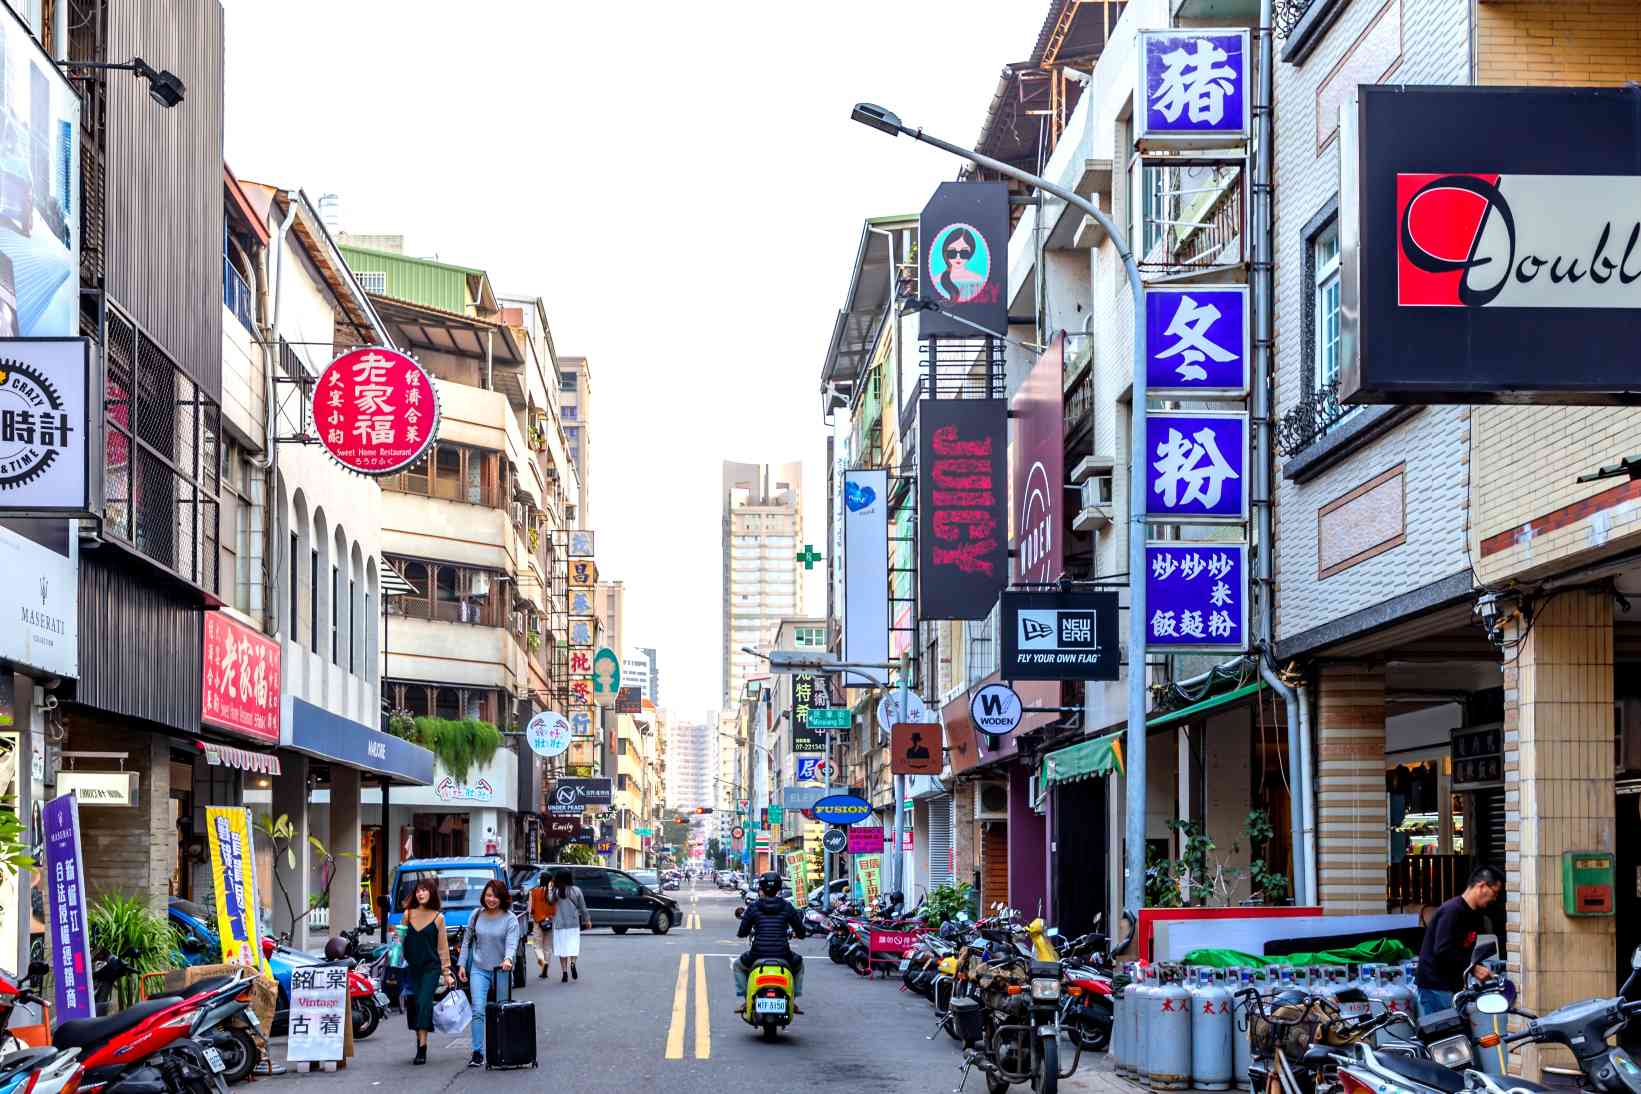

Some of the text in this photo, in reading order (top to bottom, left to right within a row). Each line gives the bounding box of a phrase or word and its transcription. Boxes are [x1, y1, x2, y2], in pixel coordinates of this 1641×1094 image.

[1152, 38, 1237, 126] 豬
[1154, 295, 1240, 381] 冬
[12, 378, 45, 408] CRAZY
[352, 352, 396, 445] 老家福
[327, 370, 345, 444] 大宴小酌
[9, 449, 40, 473] TIME
[337, 448, 412, 457] Sweet Home Restaurant
[1153, 427, 1240, 509] 粉
[932, 424, 997, 577] JUICY
[21, 606, 65, 635] MASERATI
[1062, 618, 1091, 631] NEW
[1062, 630, 1091, 642] ERA
[1017, 654, 1098, 664] FLY YOUR OWN FLAG
[980, 717, 1014, 726] WODEN
[815, 805, 868, 813] FUSION
[552, 821, 574, 833] Emily
[299, 997, 338, 1008] Vintage
